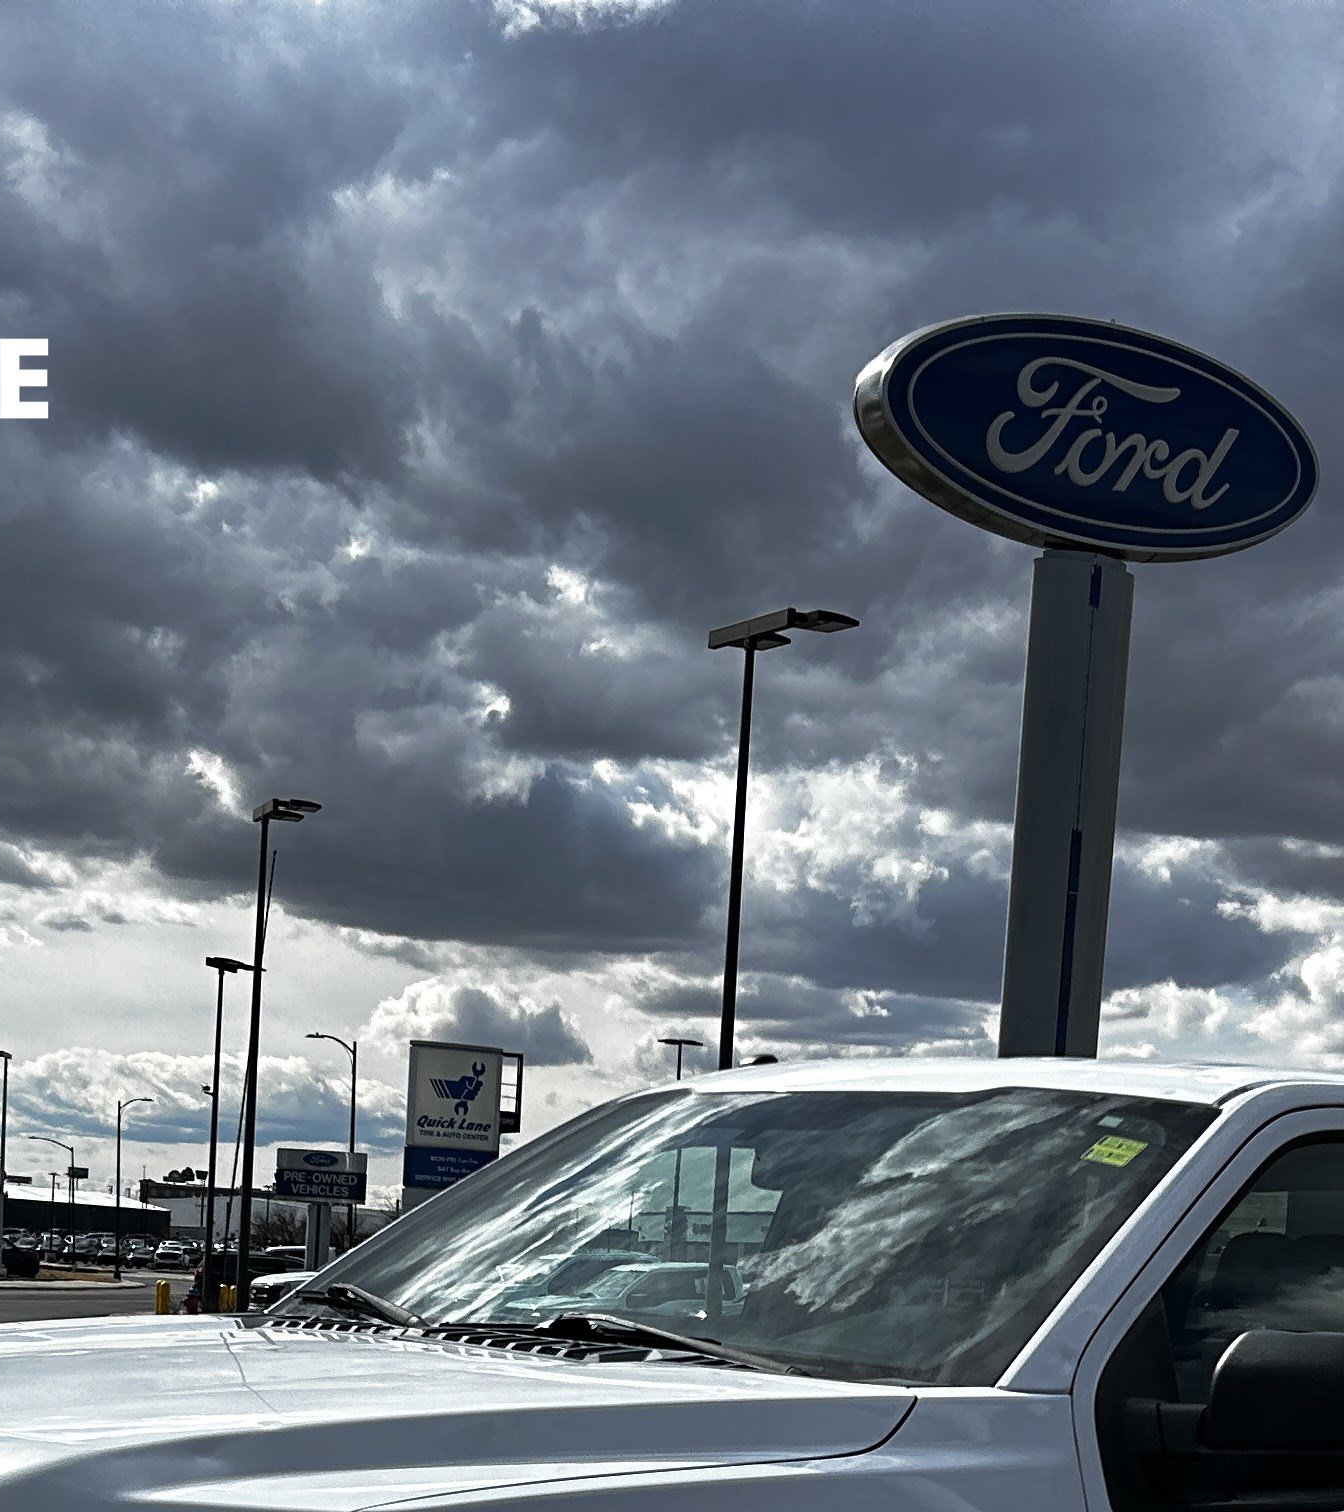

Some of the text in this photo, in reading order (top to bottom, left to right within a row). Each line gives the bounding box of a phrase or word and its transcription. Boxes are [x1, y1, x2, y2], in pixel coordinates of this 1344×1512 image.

[986, 356, 1240, 511] Ford
[416, 1115, 457, 1129] Quick
[458, 1118, 492, 1133] Lane
[419, 1129, 435, 1137] TIRE
[442, 1131, 462, 1140] AUTO
[462, 1132, 490, 1142] CENTER
[283, 1170, 358, 1186] PRE-OWNED
[290, 1183, 350, 1198] VEHICLES
